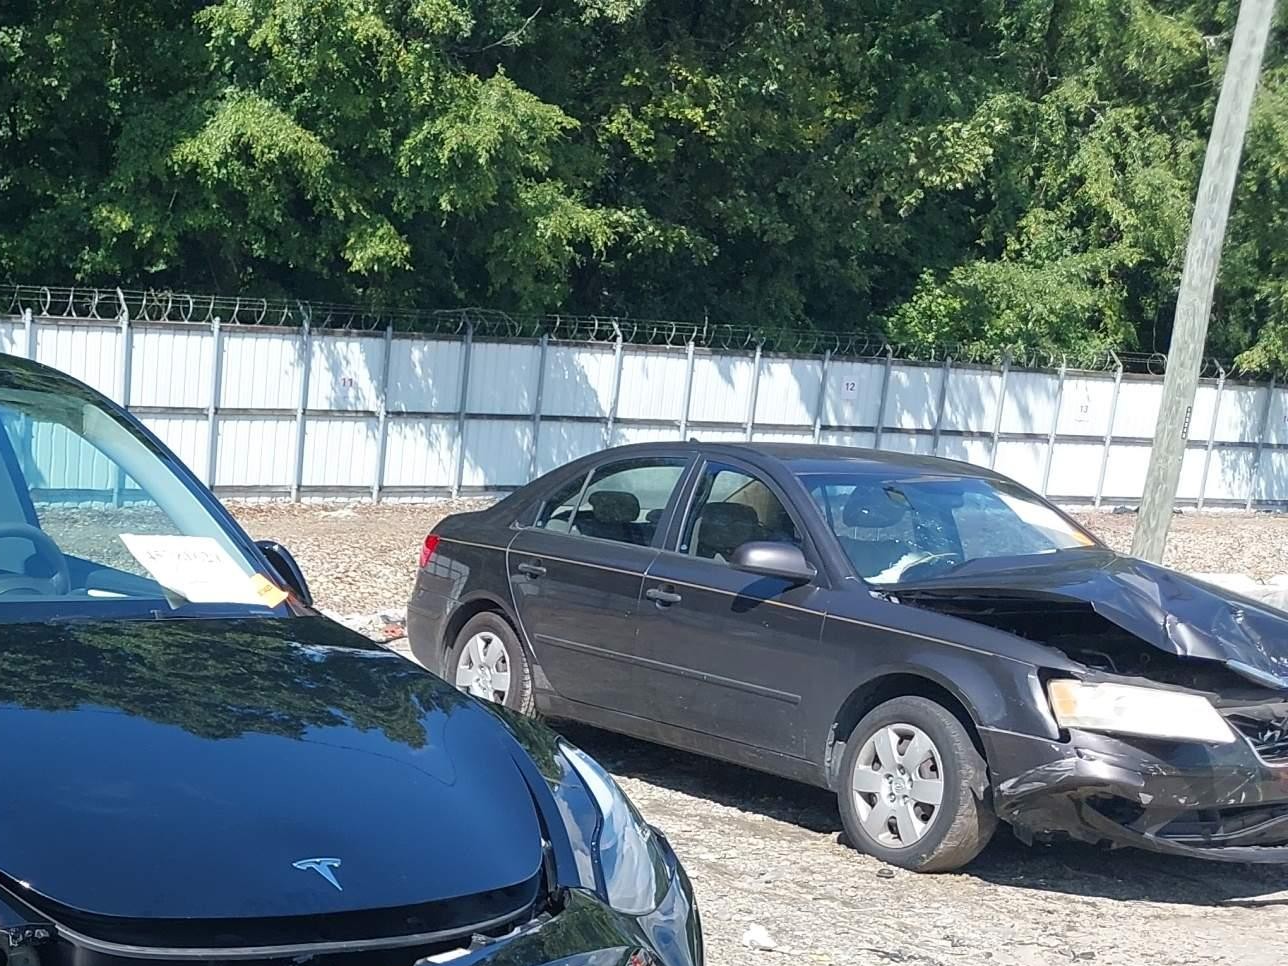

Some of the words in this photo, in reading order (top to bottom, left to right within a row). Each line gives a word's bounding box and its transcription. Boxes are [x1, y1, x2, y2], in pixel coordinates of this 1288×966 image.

[342, 378, 353, 387] 11
[845, 382, 855, 391] 12
[1079, 405, 1089, 413] 13
